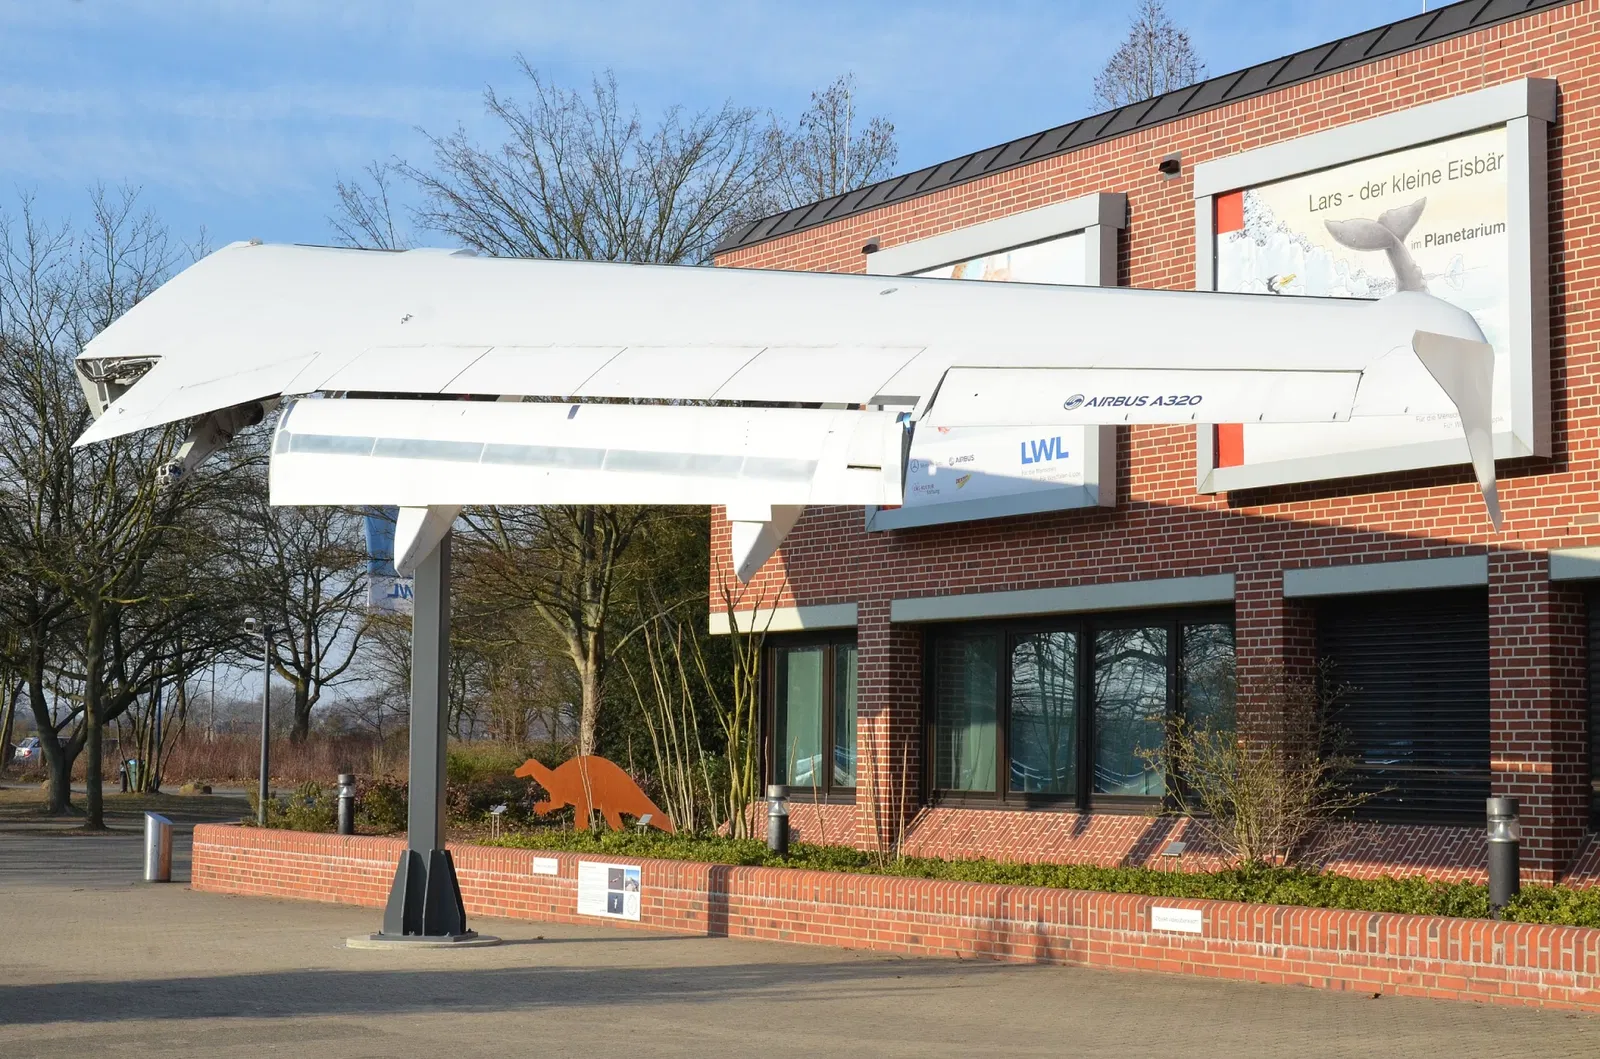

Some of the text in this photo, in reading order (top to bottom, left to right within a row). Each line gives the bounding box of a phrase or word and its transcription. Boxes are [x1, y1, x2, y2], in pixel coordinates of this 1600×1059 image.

[1309, 193, 1343, 213] Lars
[1360, 181, 1387, 201] der
[1392, 169, 1442, 194] kleine
[1448, 152, 1505, 181] Eisbär
[1411, 221, 1506, 250] im Planetarium
[1084, 395, 1203, 408] AIRBUS A320
[955, 454, 975, 463] AIRBUS
[1021, 436, 1069, 465] LWL
